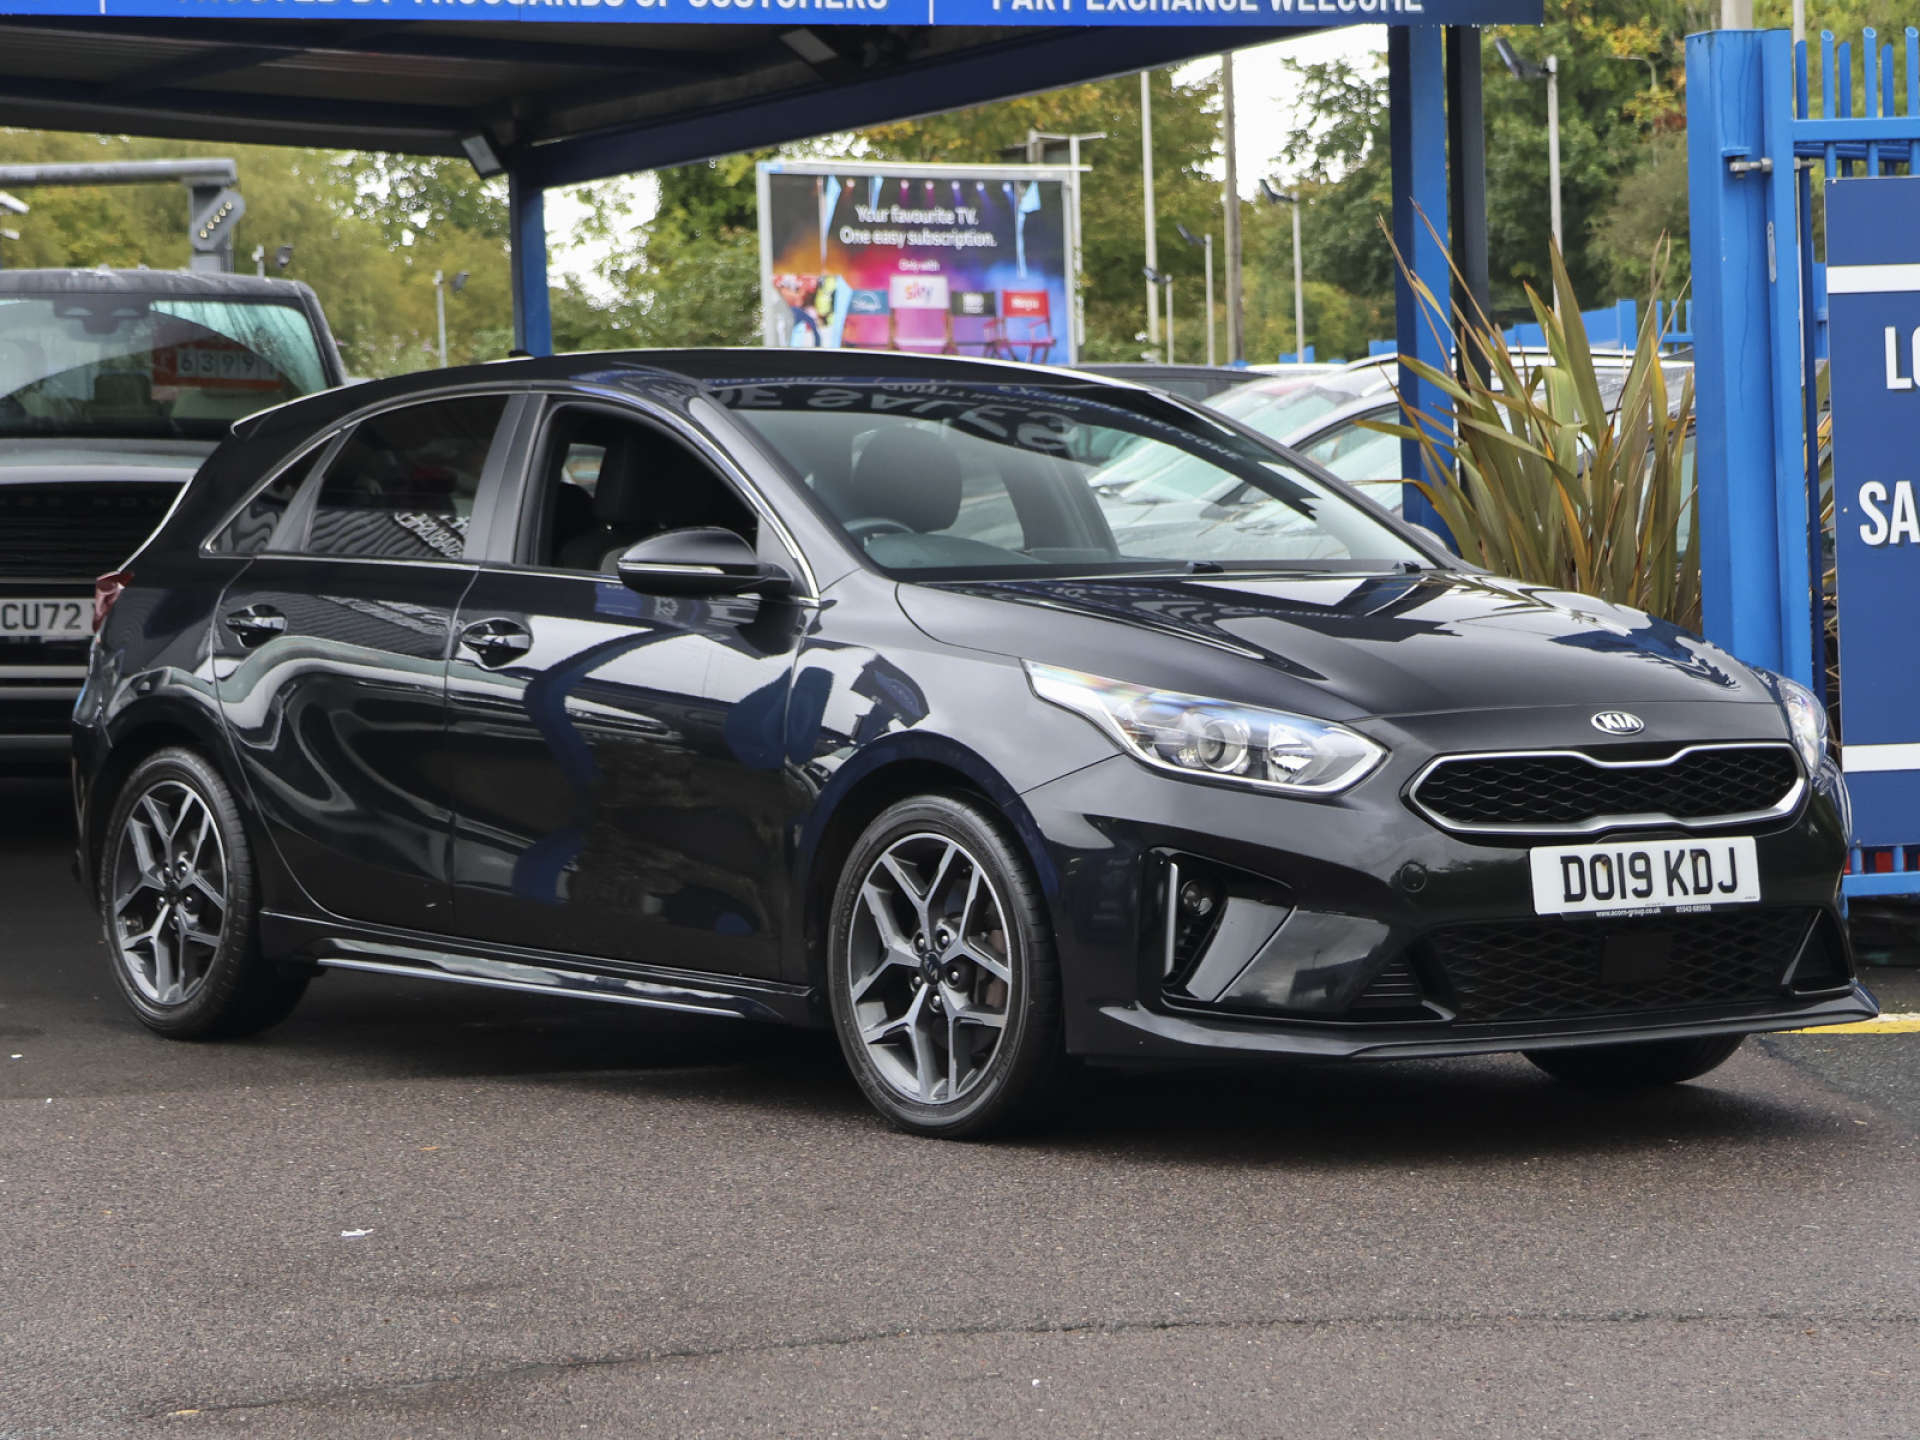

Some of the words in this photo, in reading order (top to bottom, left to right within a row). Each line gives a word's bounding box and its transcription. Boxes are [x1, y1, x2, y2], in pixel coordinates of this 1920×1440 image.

[855, 204, 889, 223] Your
[890, 204, 955, 224] favourite
[955, 206, 979, 225] TV.
[840, 226, 871, 244] One
[872, 230, 906, 248] easy
[907, 227, 998, 250] subscription.
[2, 603, 81, 630] CU72
[1597, 712, 1641, 730] KIA
[1664, 847, 1738, 897] KDJ
